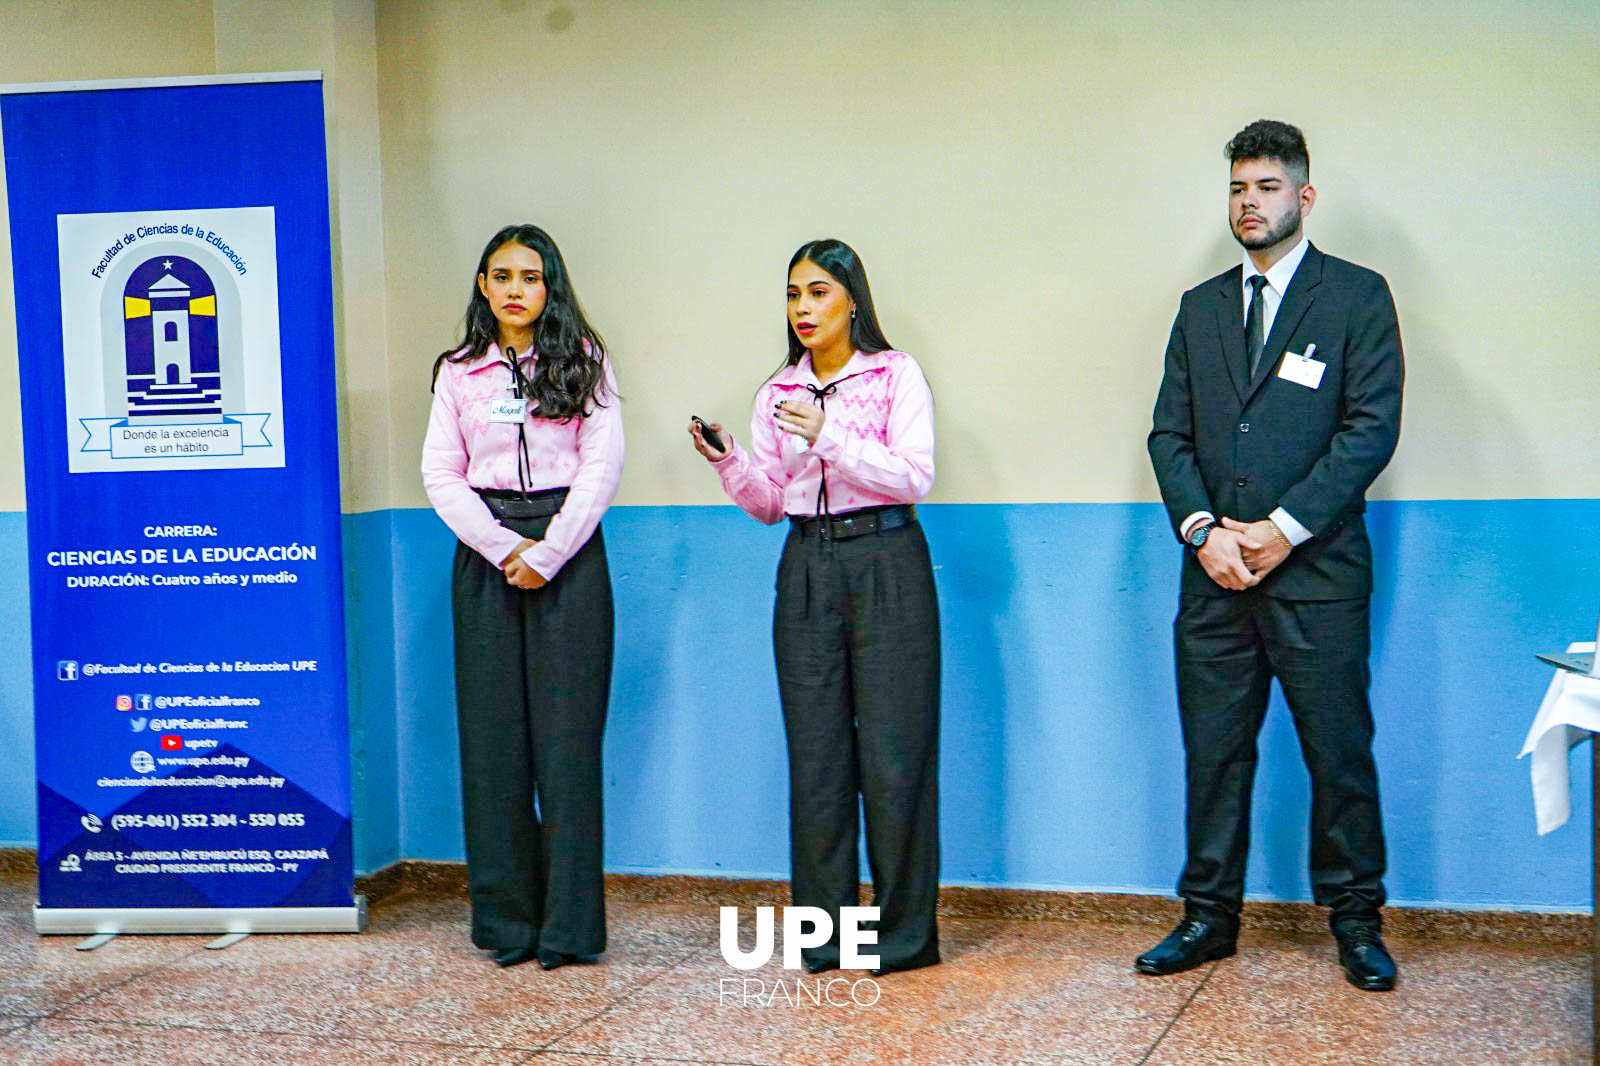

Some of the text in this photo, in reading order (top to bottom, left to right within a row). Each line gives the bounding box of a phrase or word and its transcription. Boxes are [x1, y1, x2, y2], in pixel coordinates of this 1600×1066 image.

[92, 223, 247, 278] Facultad de Ciencias de la Educación
[123, 428, 229, 440] Donde la excelencia
[144, 442, 209, 454] es un hábito
[144, 525, 218, 538] CARRERA:
[47, 543, 316, 566] CIENCIAS DE LA EDUCACIÓN
[67, 571, 298, 588] DURACIÓN: Cuatro años y medio
[82, 661, 317, 676] @Facultad de Ciencias de la Educacion UPE
[154, 696, 260, 709] @UPEoficialfranco
[184, 740, 218, 750] upetv
[157, 755, 250, 768] www.upe.edu.py
[181, 814, 208, 827] 552
[210, 813, 238, 827] 304
[249, 813, 276, 826] 550
[278, 813, 305, 826] 055
[131, 851, 181, 860] AVENIDA
[274, 848, 329, 860] CAAZAPÁ
[115, 864, 160, 874] CIUDAD
[160, 863, 228, 873] PRESIDENTE
[228, 863, 275, 873] FRANCO
[282, 863, 299, 872] PY
